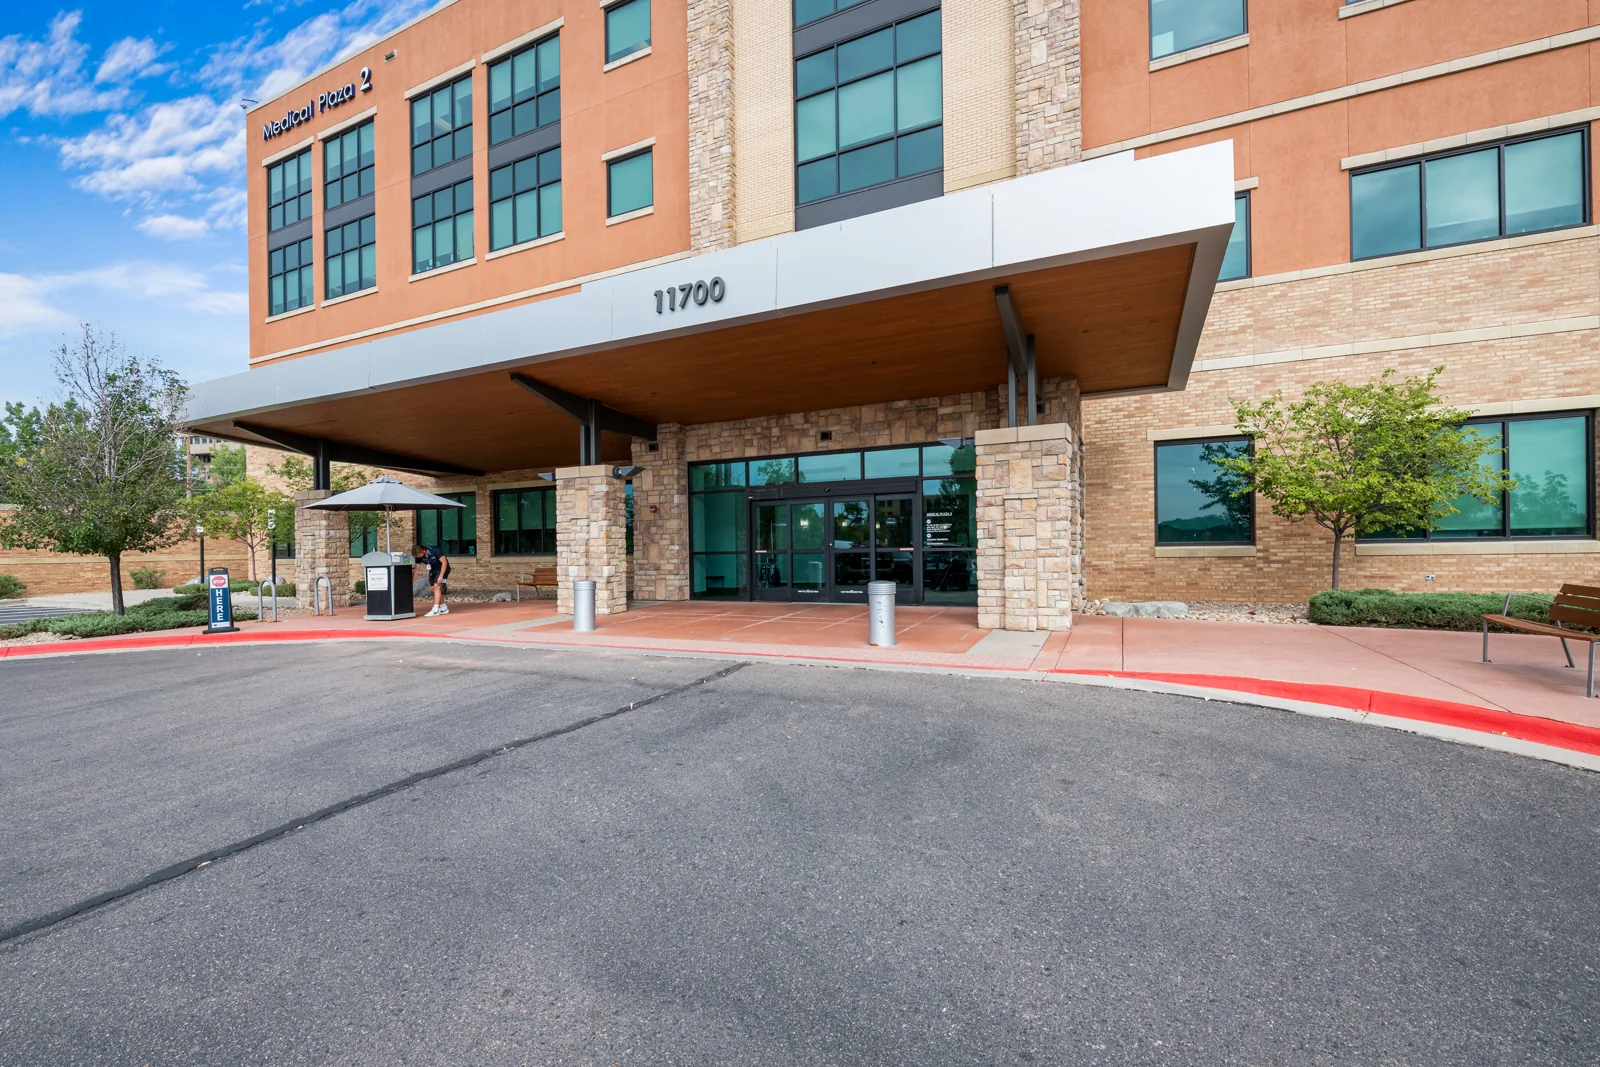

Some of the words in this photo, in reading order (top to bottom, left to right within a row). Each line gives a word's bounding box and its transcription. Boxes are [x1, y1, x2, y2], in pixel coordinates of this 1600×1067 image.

[262, 99, 314, 141] Medical
[318, 83, 356, 113] Plaza
[360, 66, 373, 92] 2
[653, 276, 726, 314] 11700
[215, 588, 224, 621] HERE
